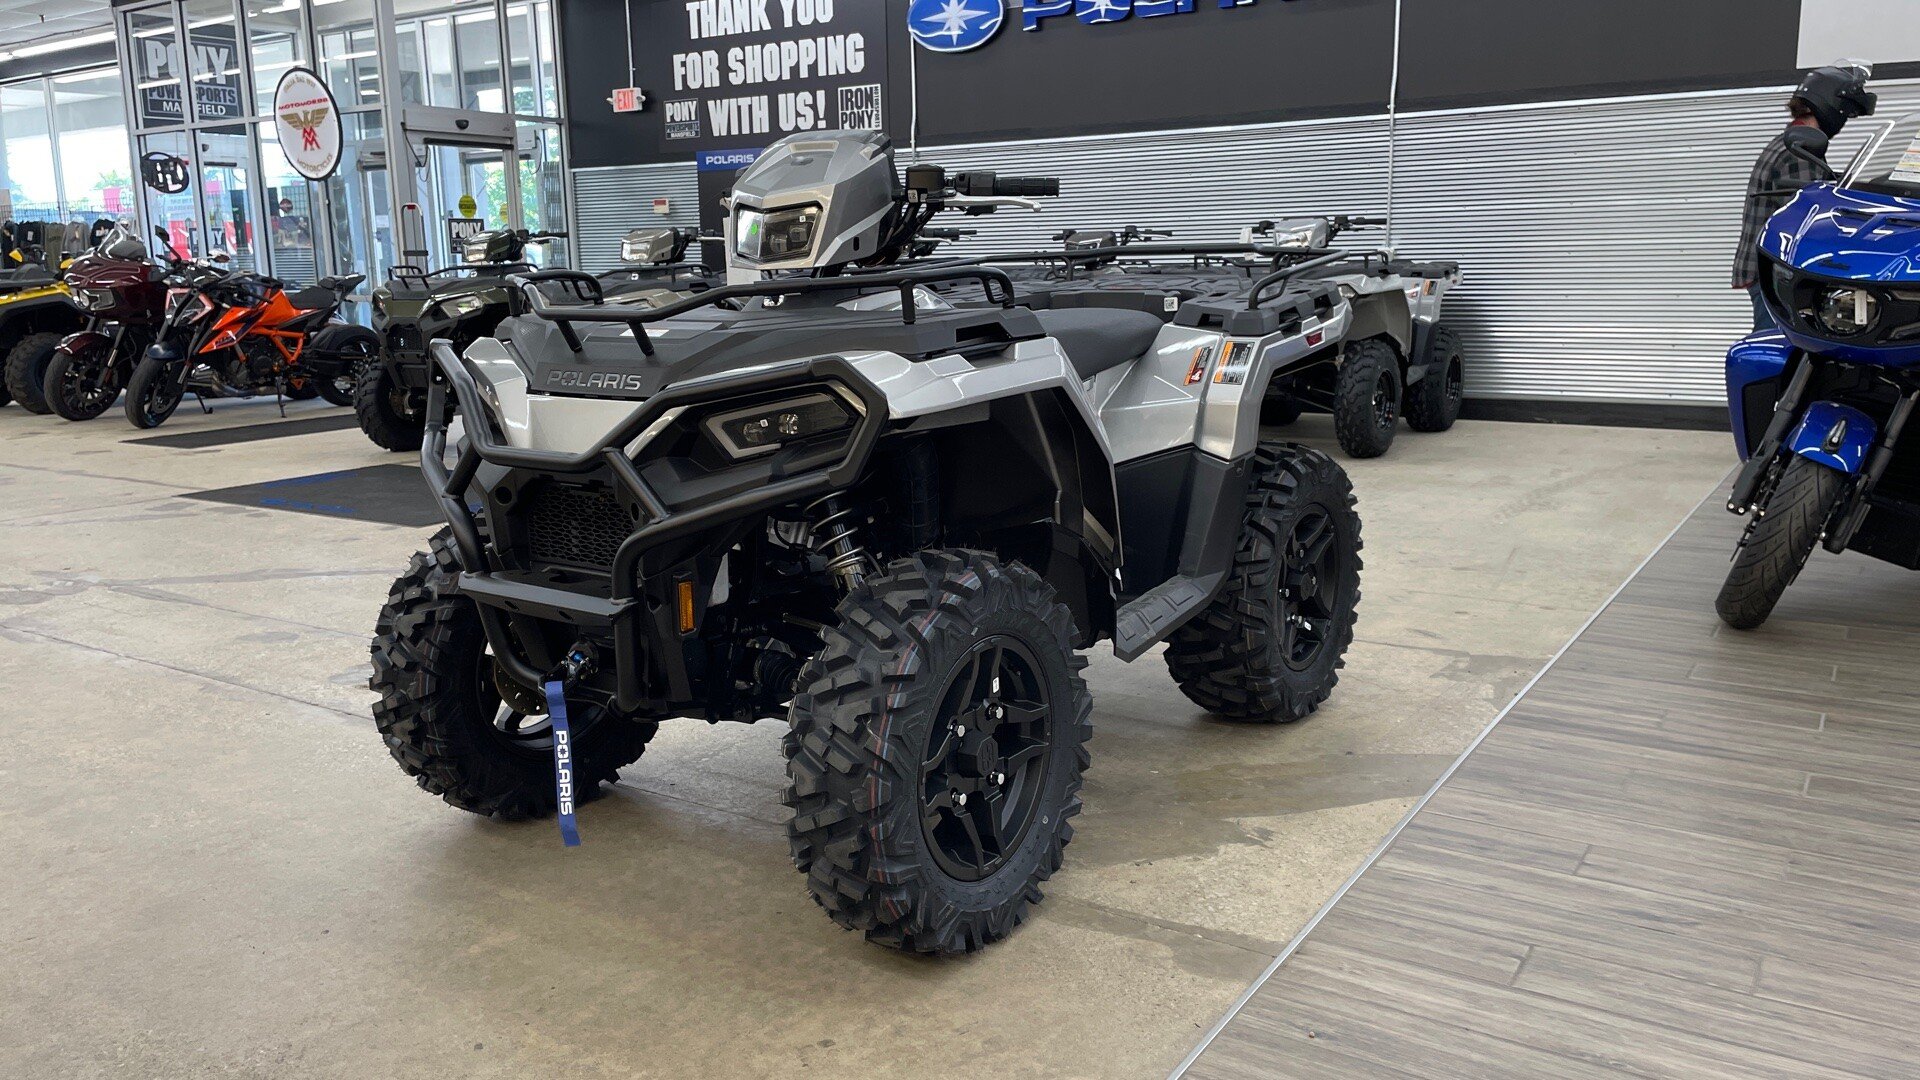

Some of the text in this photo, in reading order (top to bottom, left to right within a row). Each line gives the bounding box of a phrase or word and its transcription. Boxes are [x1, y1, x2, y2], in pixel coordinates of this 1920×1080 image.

[686, 0, 834, 39] THANK YOU
[673, 33, 865, 91] FOR SHOPPING
[149, 84, 236, 104] POWEPORTS
[616, 90, 634, 111] EXIT
[840, 87, 874, 111] IRON
[163, 101, 226, 116] MAFIELD
[665, 101, 697, 122] PONY
[707, 90, 827, 137] WITH US!
[841, 110, 874, 130] PONY
[705, 154, 754, 165] POLARIS
[451, 222, 481, 238] PONY
[546, 369, 642, 391] POLARIS
[555, 730, 573, 816] POLARIS
